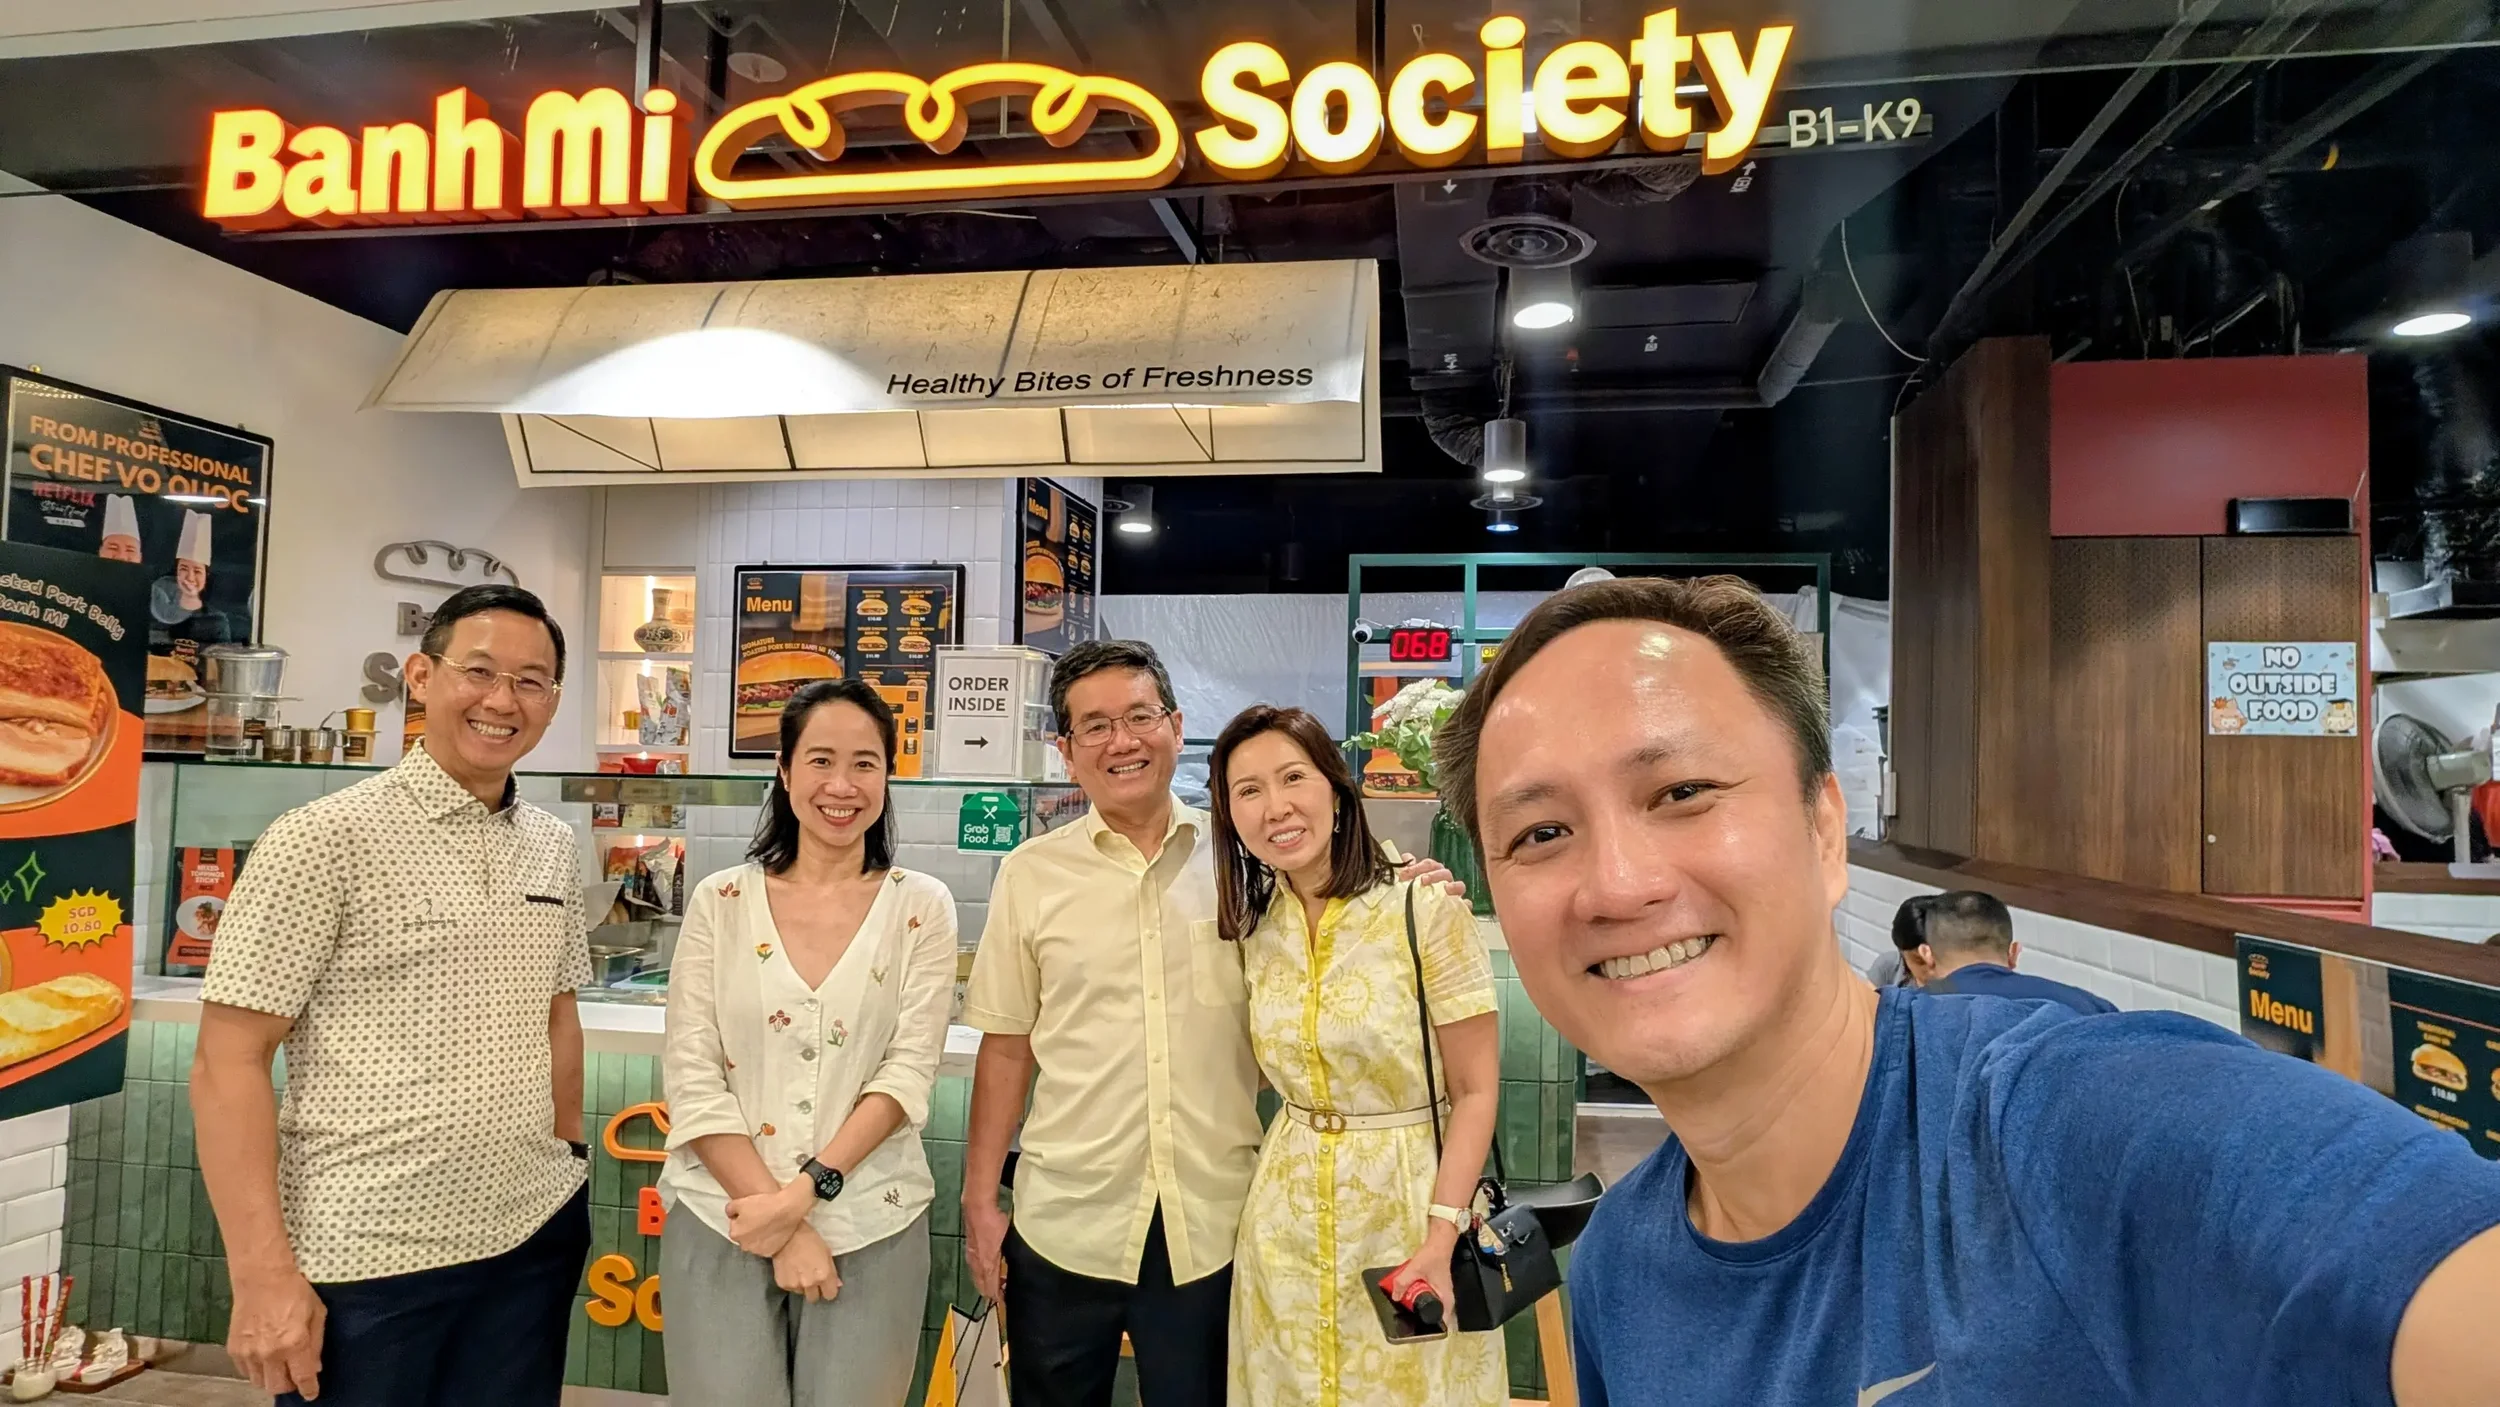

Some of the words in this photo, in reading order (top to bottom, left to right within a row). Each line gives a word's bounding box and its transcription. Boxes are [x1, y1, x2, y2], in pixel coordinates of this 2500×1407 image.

[203, 86, 505, 220] Banh
[522, 86, 679, 208] Mi
[1195, 6, 1794, 170] Society
[1789, 98, 1921, 148] B1-K9
[886, 373, 1004, 398] Healthy
[1014, 371, 1090, 392] Bites
[1102, 367, 1135, 389] of
[1143, 365, 1313, 388] Freshness
[30, 415, 97, 448] FROM
[103, 433, 252, 485] PROFESSIONAL
[29, 443, 112, 482] CHEF
[116, 461, 161, 493] VO
[1029, 498, 1048, 520] Menu
[46, 585, 88, 613] Pork
[88, 604, 125, 640] Belly
[746, 597, 792, 612] Menu
[43, 608, 69, 628] Mi
[397, 602, 431, 636] B
[1392, 632, 1449, 658] 068
[2264, 646, 2301, 669] NO
[361, 651, 404, 703] S
[949, 677, 1009, 691] ORDER
[2228, 672, 2337, 695] OUTSIDE
[949, 697, 1006, 711] INSIDE
[2247, 699, 2318, 721] FOOD
[964, 824, 989, 833] Grab
[964, 834, 989, 844] Food
[69, 906, 97, 919] SGD
[63, 919, 102, 934] 10.80
[2250, 989, 2313, 1034] Menu
